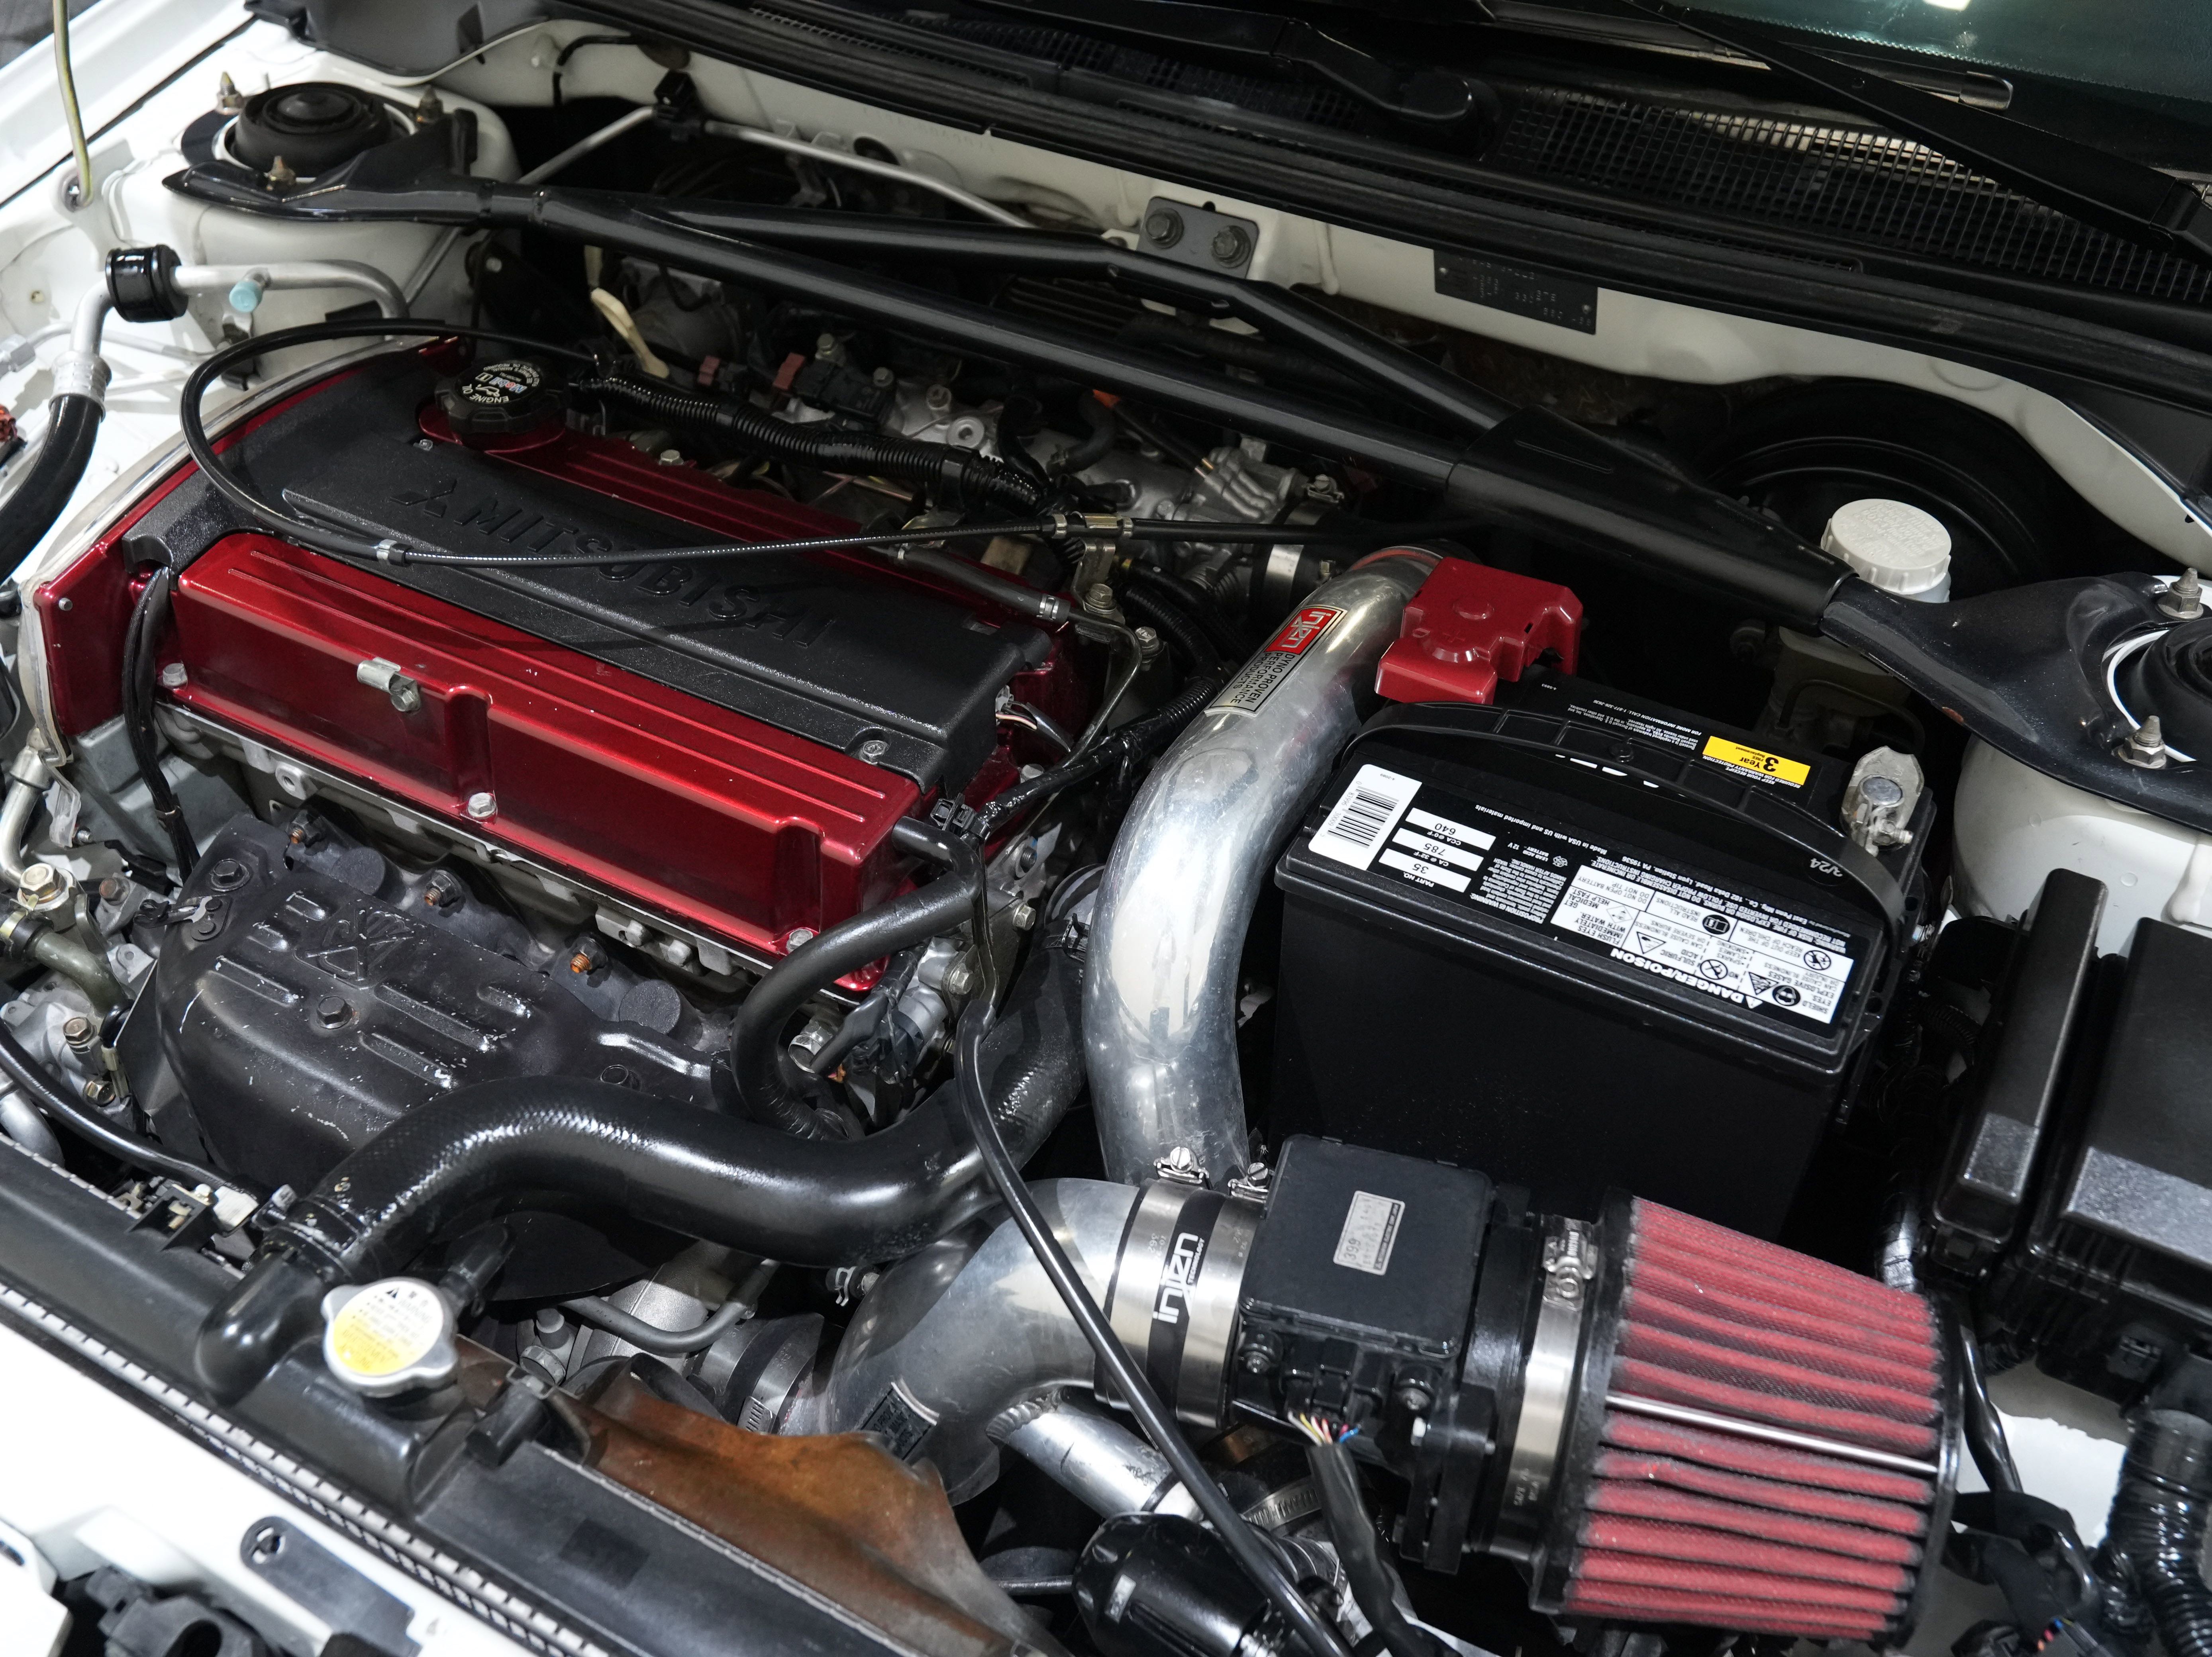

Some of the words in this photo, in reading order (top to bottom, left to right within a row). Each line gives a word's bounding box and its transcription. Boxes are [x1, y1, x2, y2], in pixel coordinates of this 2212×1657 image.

[462, 383, 473, 394] OIL
[488, 376, 527, 393] Mobil
[469, 393, 509, 402] ENGINE
[454, 497, 840, 648] MITSUBISHI
[1272, 654, 1294, 674] DYNO
[1233, 652, 1271, 689] PRODUCTS
[1230, 652, 1279, 704] PERFORMANCE
[1245, 674, 1277, 703] PROVEN
[1640, 713, 1677, 728] INFORMATION
[1675, 724, 1692, 733] MORE
[1735, 746, 1766, 758] Replacement
[1738, 756, 1761, 768] Year
[1762, 755, 1780, 774] 3
[1734, 765, 1765, 778] WARRANTY
[1760, 777, 1775, 785] KEEP
[1774, 777, 1801, 789] REQUIRED
[1341, 791, 1355, 806] 83996
[1473, 804, 1504, 819] materials
[1328, 811, 1341, 826] 30009
[1502, 813, 1532, 828] imported
[1433, 822, 1457, 835] 640
[1530, 823, 1544, 833] and
[1542, 828, 1554, 836] US
[1445, 836, 1462, 846] CCA
[1552, 831, 1569, 842] with
[1566, 836, 1583, 846] USA
[1422, 842, 1447, 856] 785
[1588, 843, 1608, 855] Made
[1437, 858, 1450, 867] CA
[1492, 857, 1509, 866] WASH
[1620, 855, 1642, 868] 19536
[1641, 862, 1652, 871] PA
[1411, 862, 1430, 874] 35
[1534, 866, 1551, 876] AFTER
[1401, 871, 1416, 881] NO.
[1414, 876, 1435, 887] PART
[1549, 872, 1567, 882] HANDS
[1625, 872, 1636, 880] OR
[1639, 871, 1673, 887] CHARGING
[1676, 874, 1694, 885] Lyon
[1605, 885, 1622, 895] OPEN
[1624, 885, 1639, 895] NOT
[1635, 875, 1678, 895] DISASSEMBLE
[1671, 881, 1698, 895] PROPER
[1570, 887, 1590, 899] FAST.
[1623, 891, 1637, 901] NOT
[1639, 891, 1650, 899] DO
[1677, 890, 1692, 900] NOT
[1696, 890, 1724, 905] FOLLOW
[1712, 887, 1731, 898] Deka
[1729, 893, 1744, 903] 102
[1563, 898, 1579, 909] GET
[1566, 893, 1600, 909] MEDICAL
[1590, 895, 1610, 906] HELP
[1690, 895, 1702, 903] DO
[1504, 905, 1545, 924] PROPOSITION
[1668, 907, 1680, 916] ALL
[1679, 911, 1699, 923] READ
[1724, 907, 1736, 915] OR
[1737, 905, 1769, 921] INVERTED
[1774, 908, 1793, 920] Penn
[1578, 911, 1606, 926] WATER.
[1735, 910, 1771, 928] EXPLOSION
[1768, 915, 1783, 925] FOR
[1791, 914, 1808, 925] East
[1573, 917, 1624, 939] IMMEDIATELY
[1577, 924, 1596, 936] EYES
[1606, 922, 1626, 933] WITH
[1633, 920, 1669, 937] BLINDNESS
[1671, 927, 1697, 940] SEVERE
[1782, 920, 1832, 942] RECOMMENDED
[1786, 928, 1798, 937] OF
[1596, 932, 1620, 945] FLUSH
[1668, 932, 1689, 944] CAUSE
[1747, 935, 1759, 943] THE
[1796, 931, 1814, 943] RISK
[1831, 937, 1846, 947] NOT
[1689, 940, 1704, 950] CAN
[1770, 943, 1784, 952] OUT
[1781, 941, 1803, 953] REACH
[1659, 948, 1696, 966] SULFURIC
[1680, 948, 1699, 960] ACID
[1784, 948, 1801, 958] KEEP
[1609, 946, 1745, 1004] DANGER/POISON
[1767, 970, 1792, 984] GASES
[1793, 979, 1835, 999] EXPLOSIVE
[1801, 999, 1829, 1015] SHIELD
[1184, 1237, 1207, 1285] TECHNOLOGY
